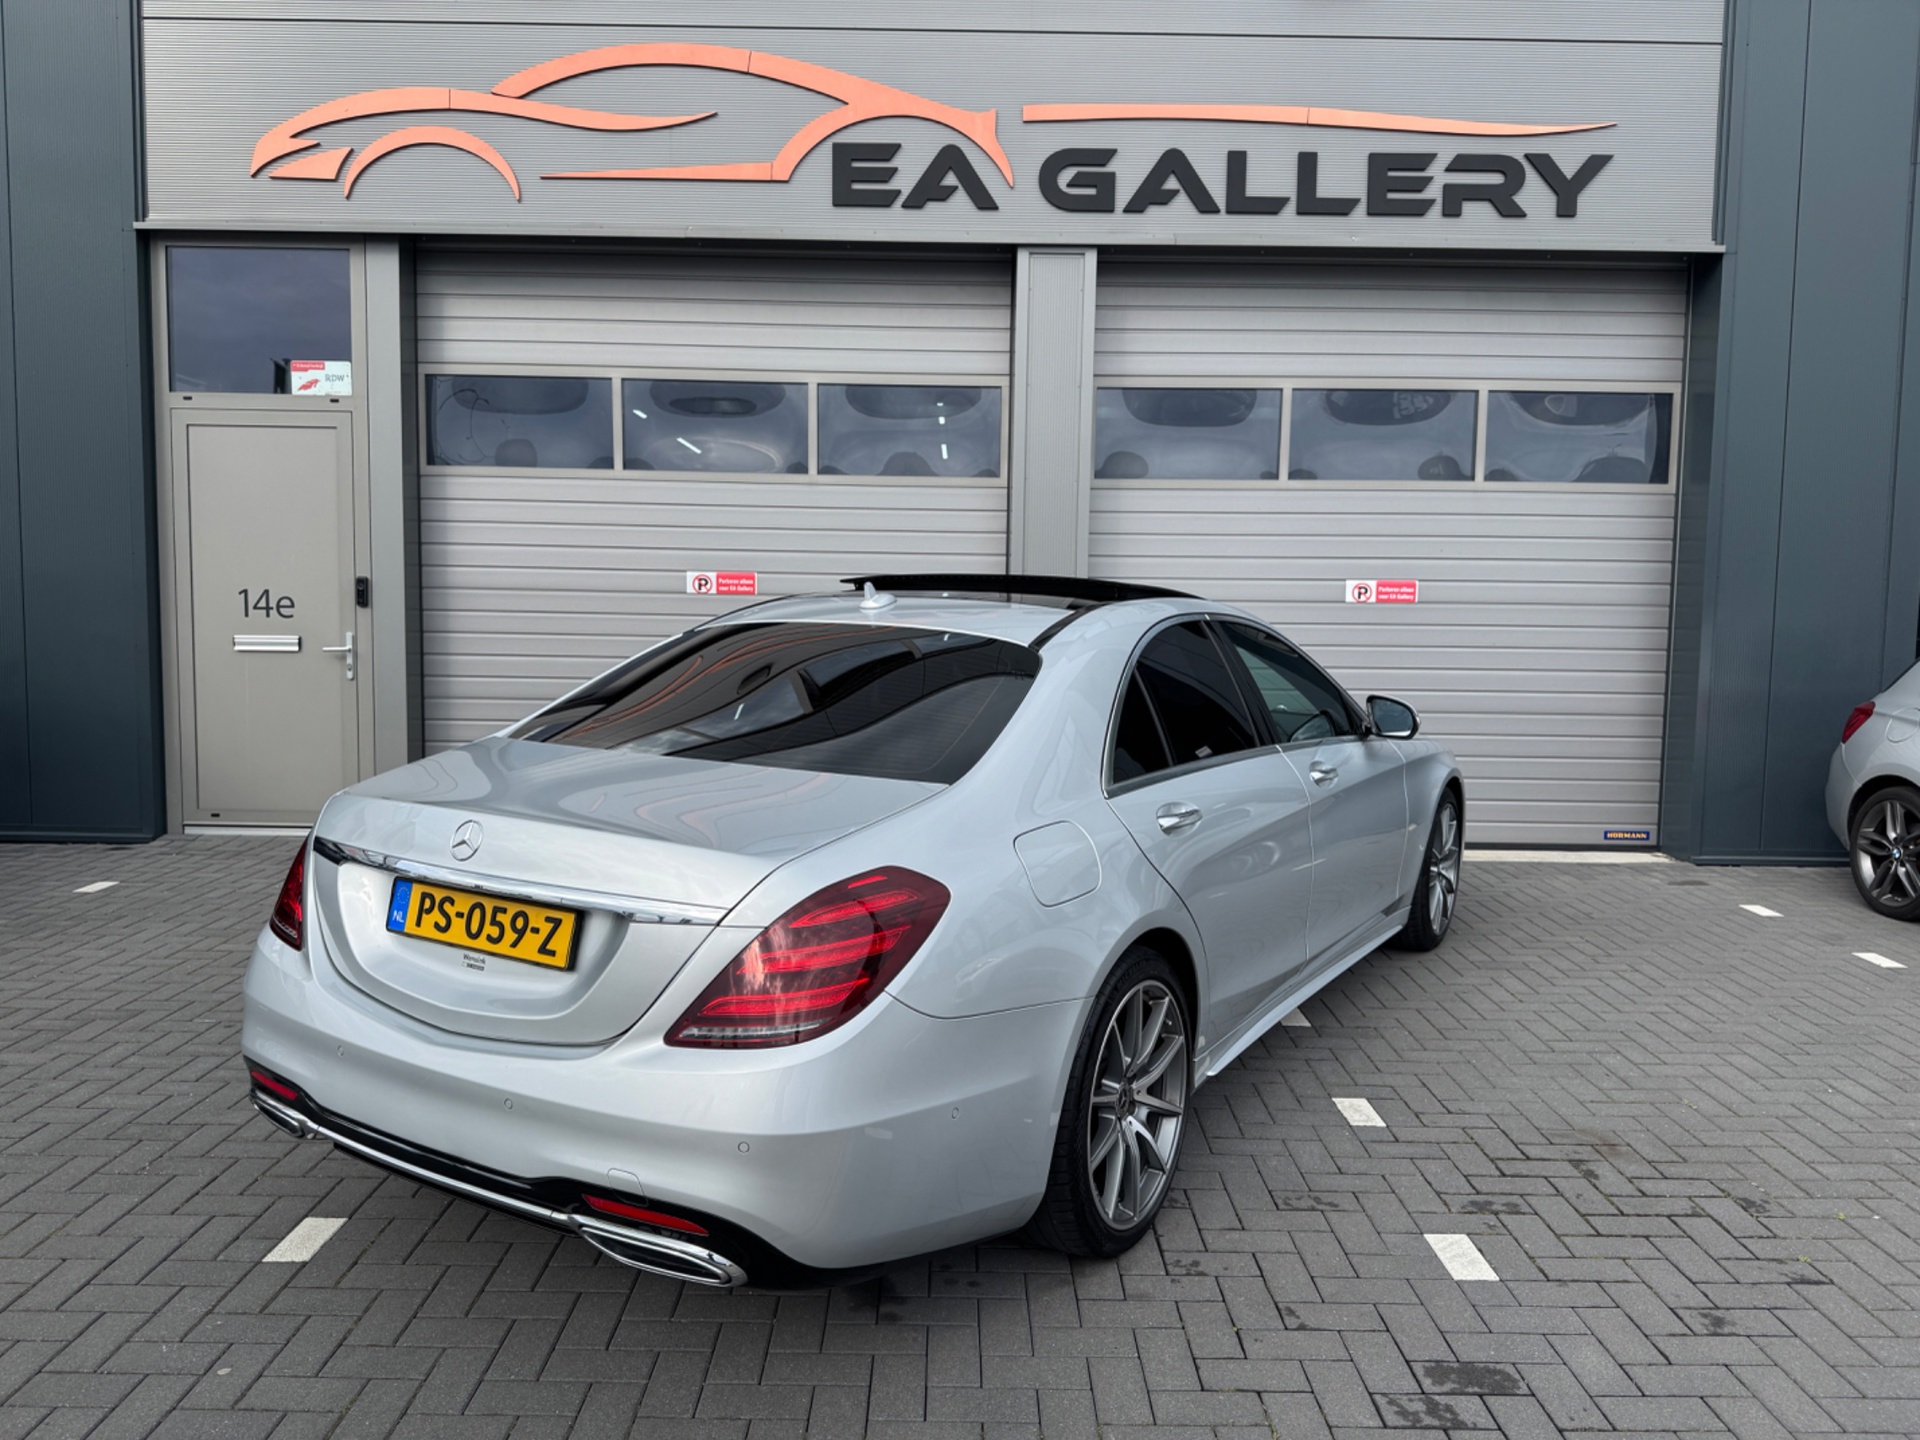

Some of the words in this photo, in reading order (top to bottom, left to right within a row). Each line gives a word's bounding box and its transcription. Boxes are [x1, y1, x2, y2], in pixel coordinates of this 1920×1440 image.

[832, 142, 999, 211] EA
[1038, 147, 1614, 218] GALLERY
[238, 588, 296, 619] 14e
[392, 910, 405, 923] NL
[415, 891, 563, 958] PS-059-Z
